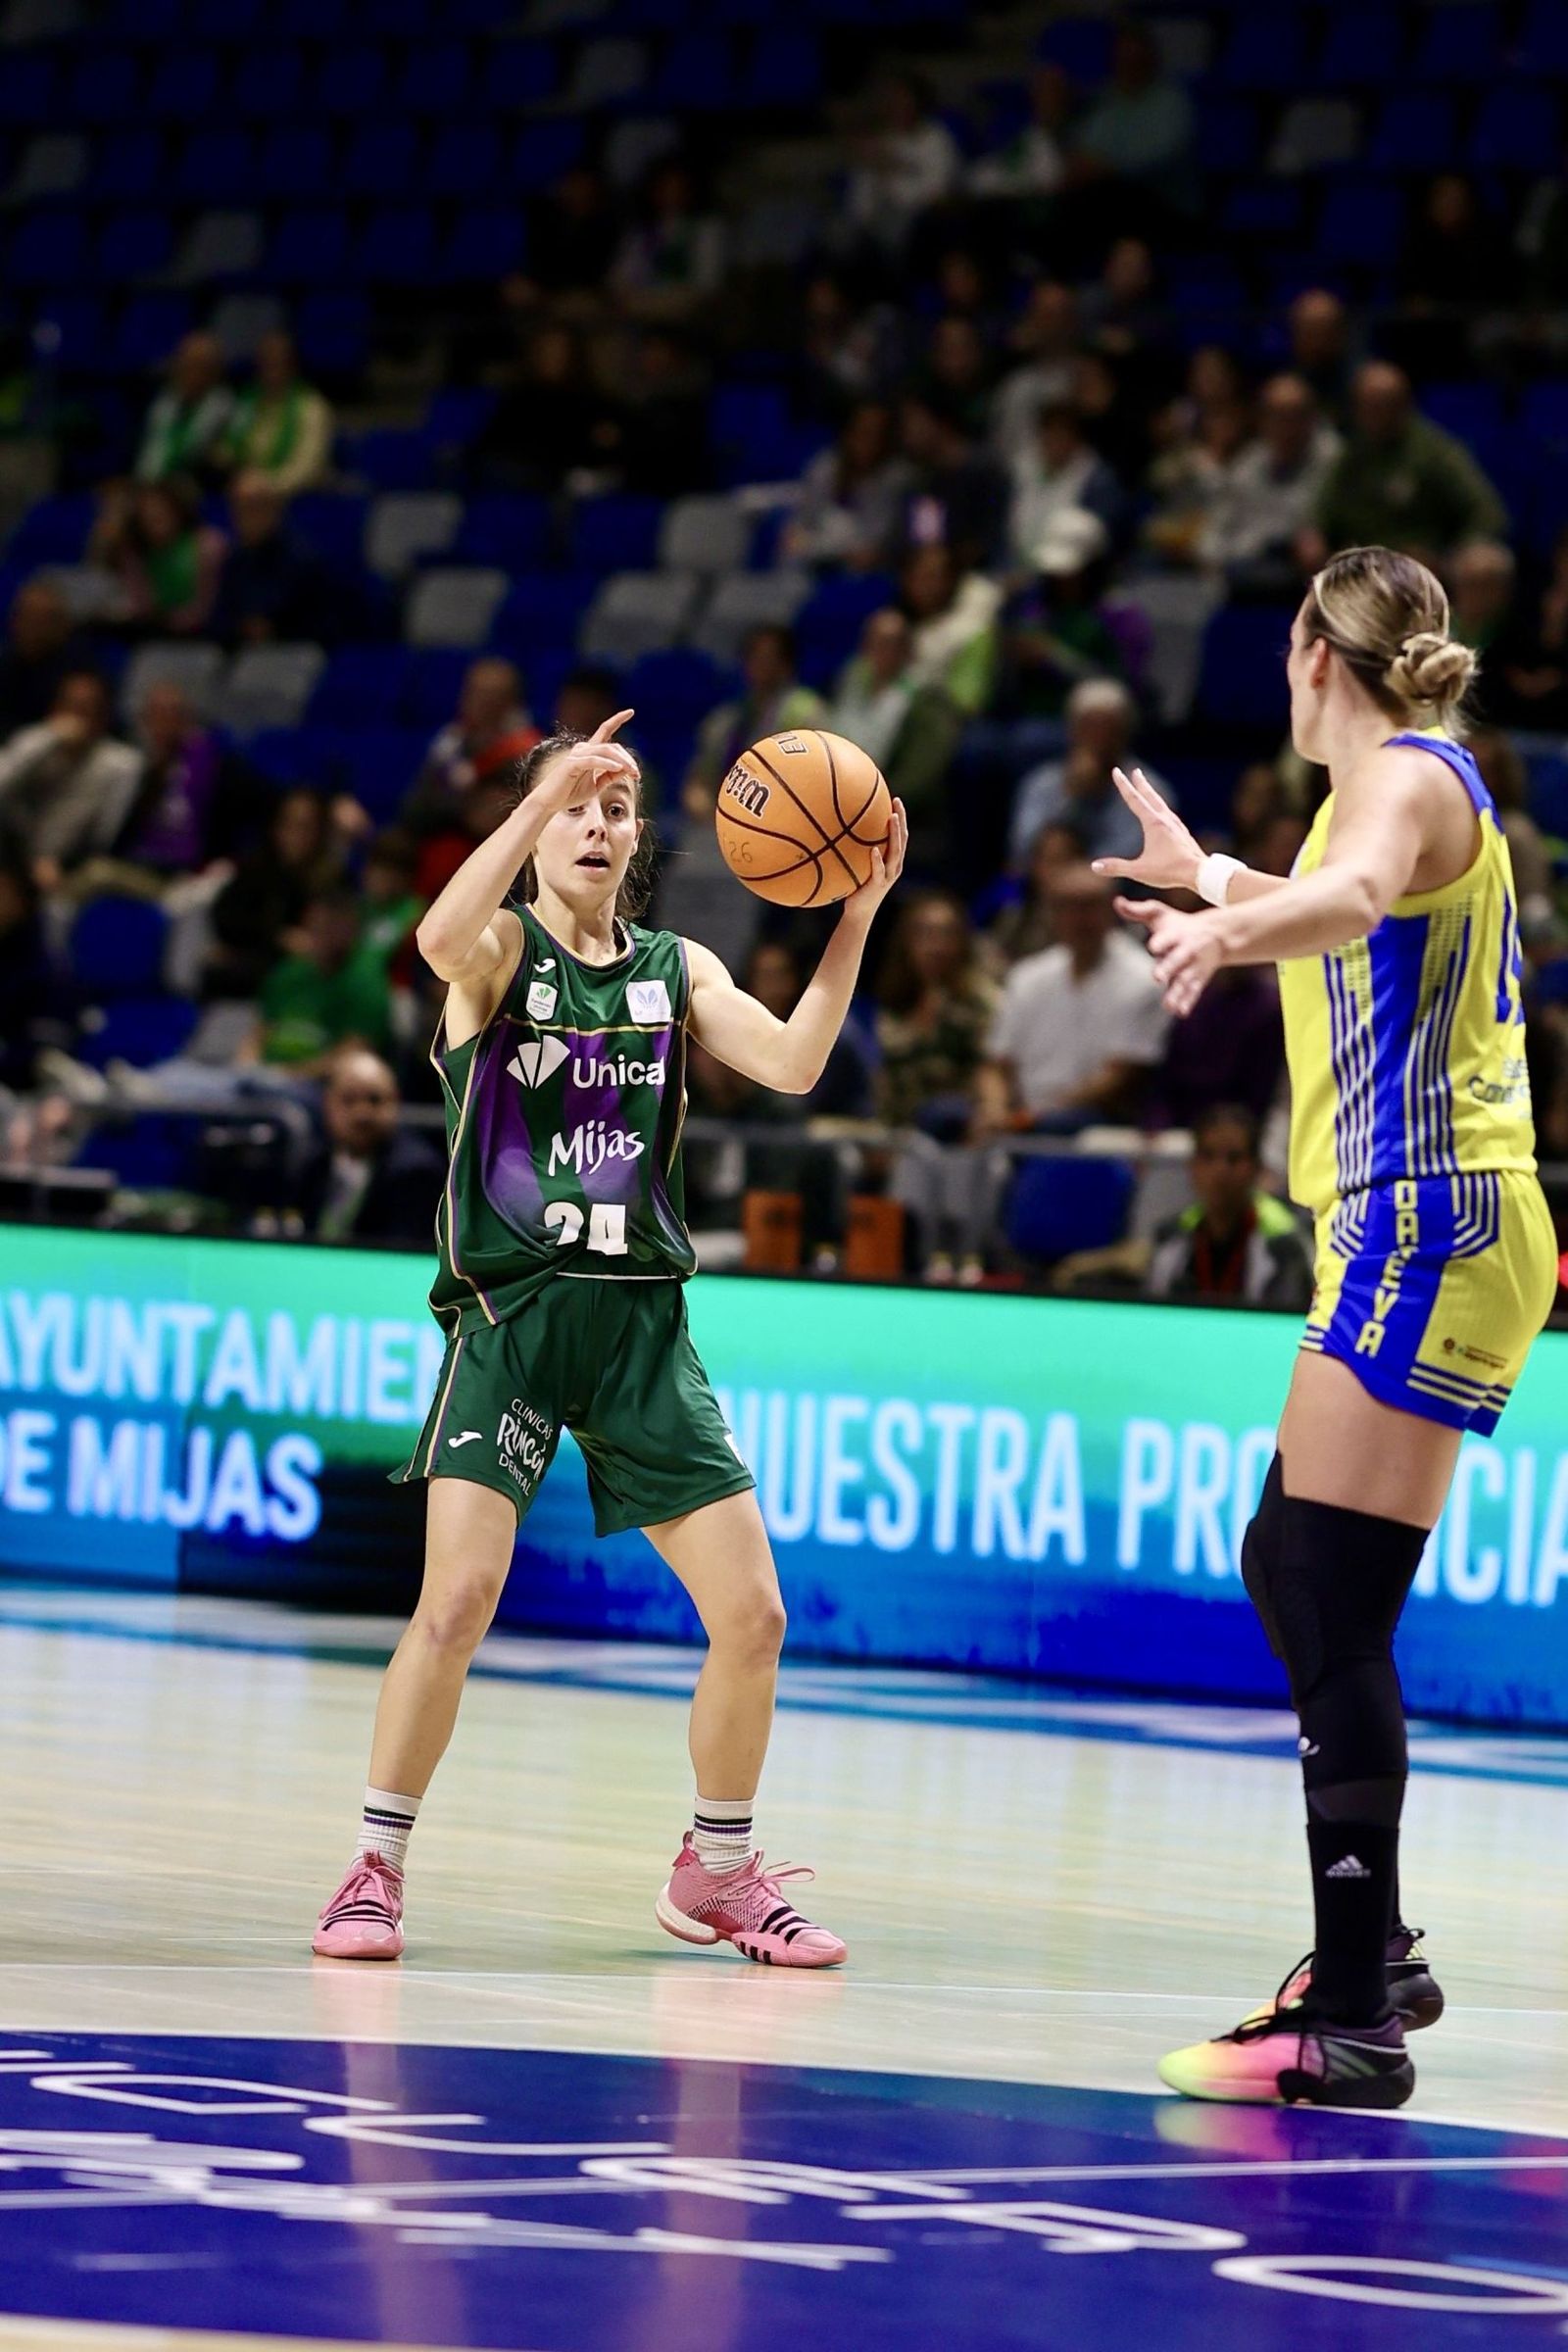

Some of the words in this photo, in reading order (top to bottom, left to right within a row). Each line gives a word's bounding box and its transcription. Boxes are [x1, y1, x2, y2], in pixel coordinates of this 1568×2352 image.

[547, 1119, 646, 1177] Mijas
[543, 1200, 629, 1256] 24
[66, 1412, 323, 1544] MIJAS
[498, 1452, 532, 1496] DENTAL
